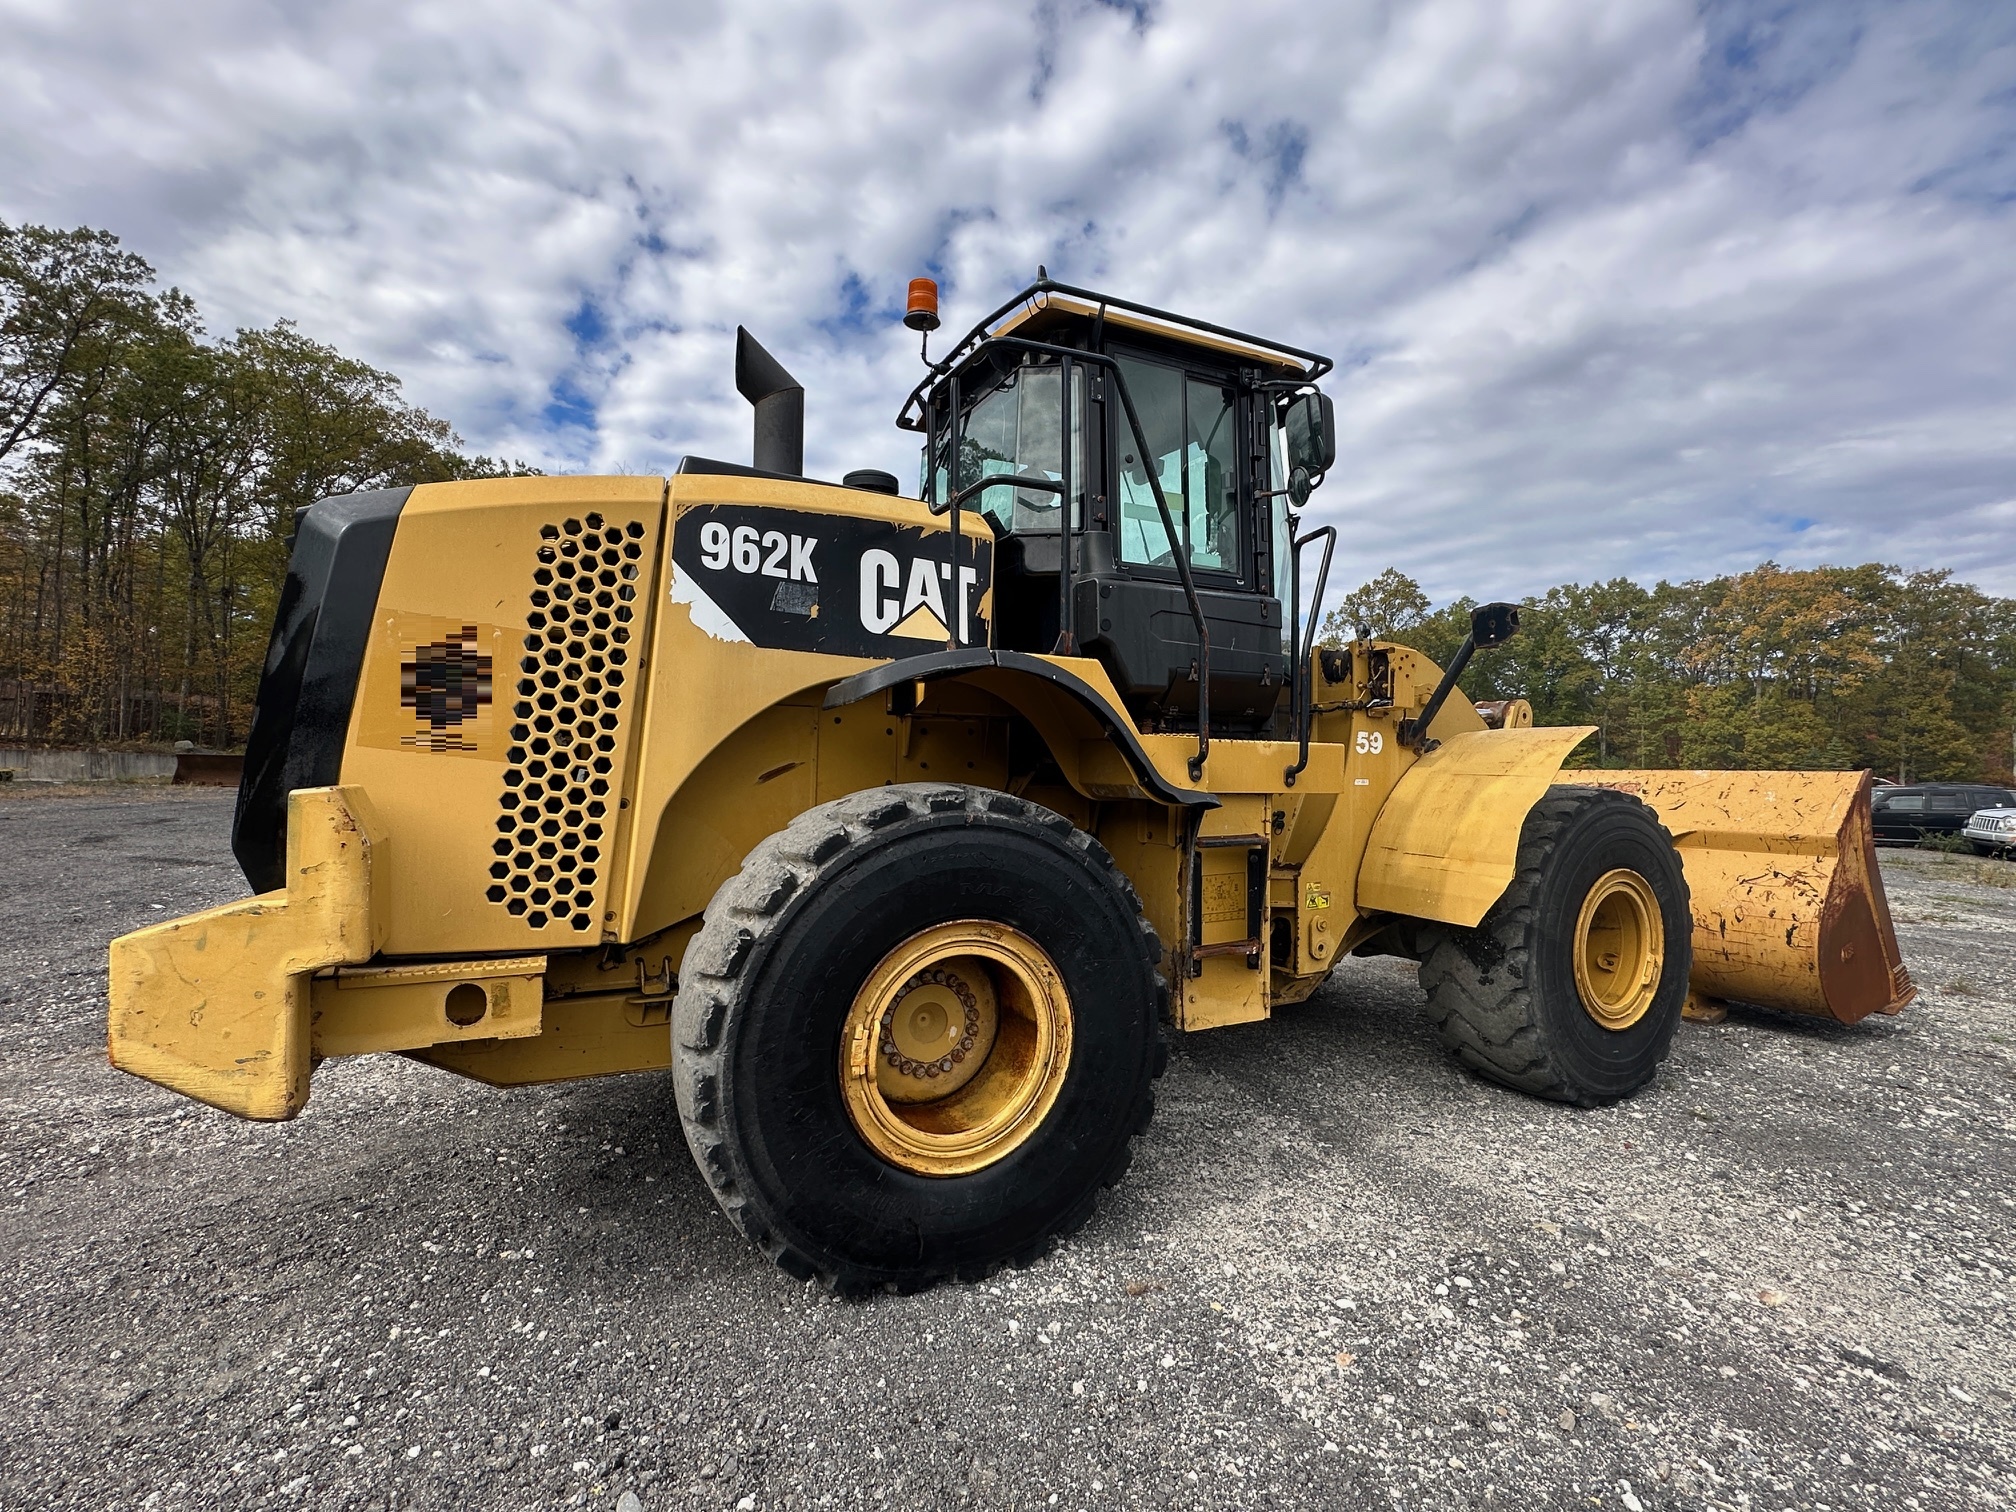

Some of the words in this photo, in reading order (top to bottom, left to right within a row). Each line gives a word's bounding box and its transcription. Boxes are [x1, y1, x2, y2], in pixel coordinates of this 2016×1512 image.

[700, 522, 818, 583] 962K
[860, 548, 976, 645] CAT
[1355, 731, 1383, 755] 59
